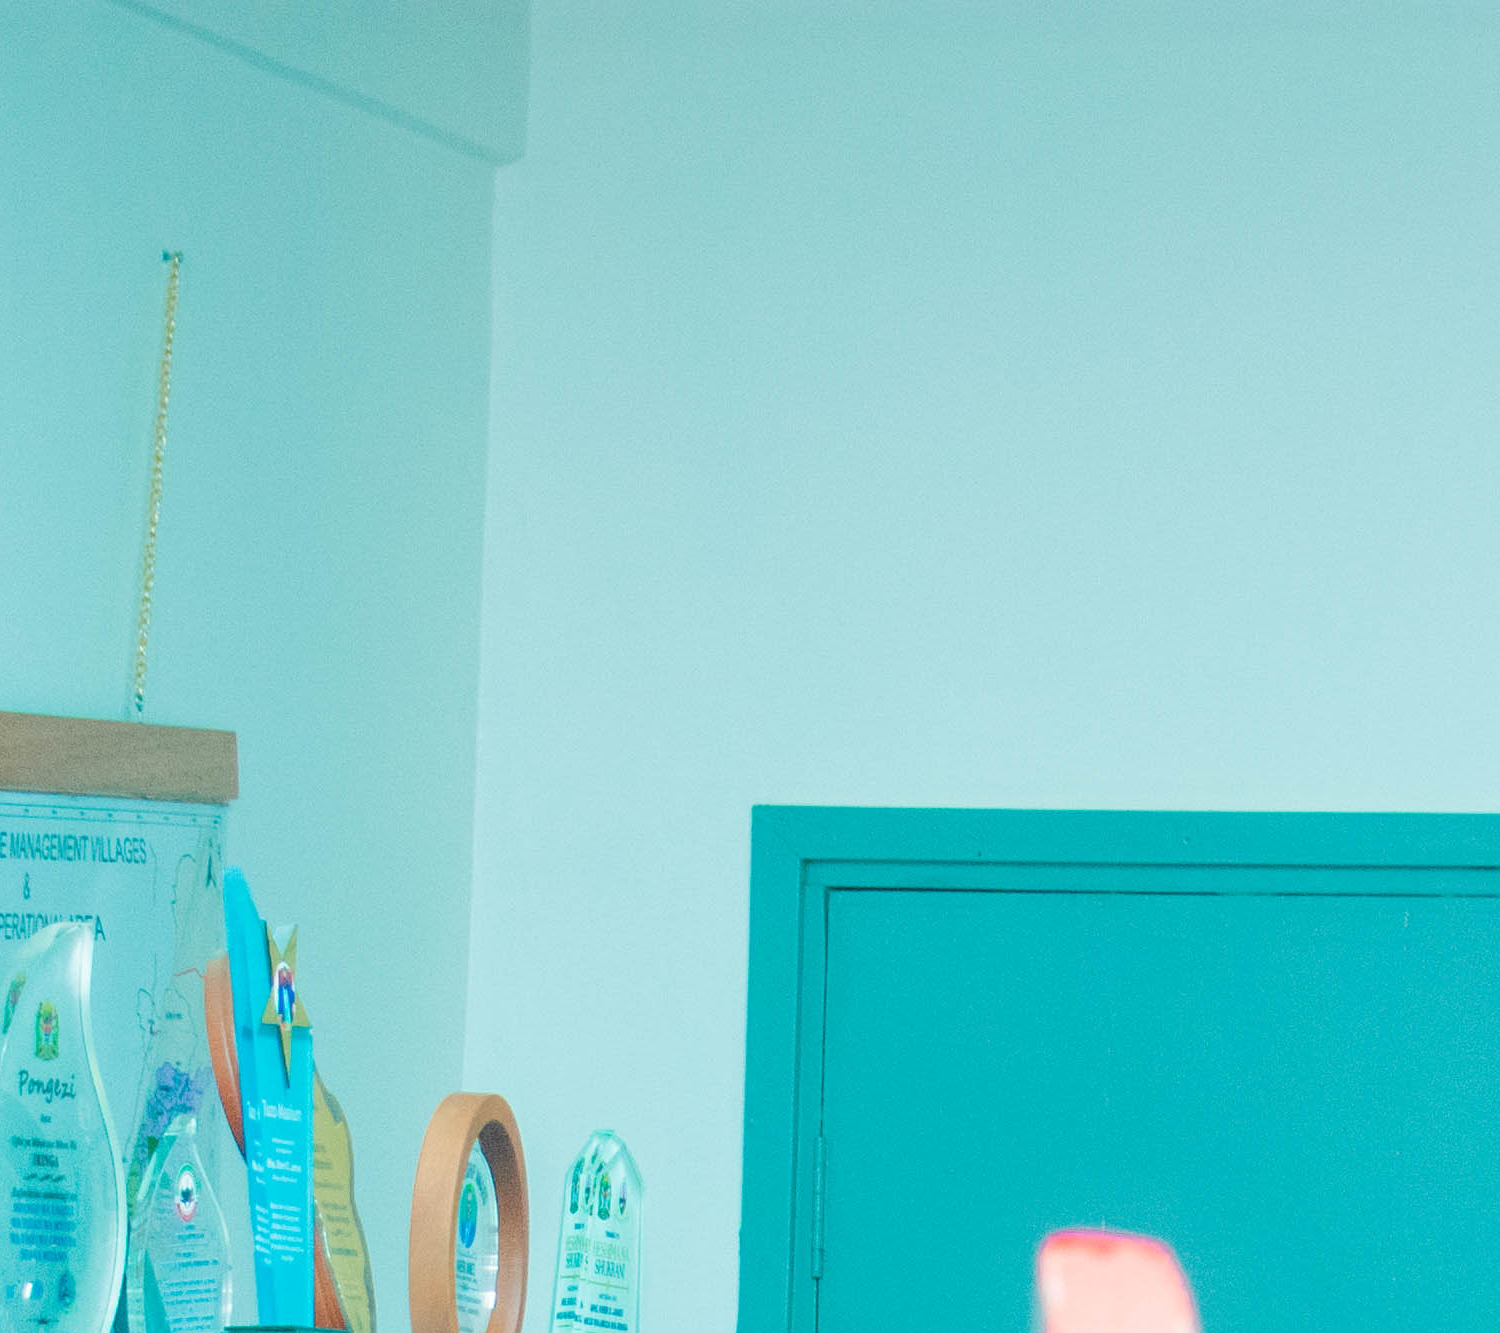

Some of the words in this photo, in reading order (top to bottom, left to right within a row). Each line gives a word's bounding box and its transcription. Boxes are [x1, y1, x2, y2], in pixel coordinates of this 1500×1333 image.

[9, 832, 90, 862] MANAGEMENT
[91, 836, 147, 865] VILLAGES
[18, 1066, 77, 1105] Pongezi
